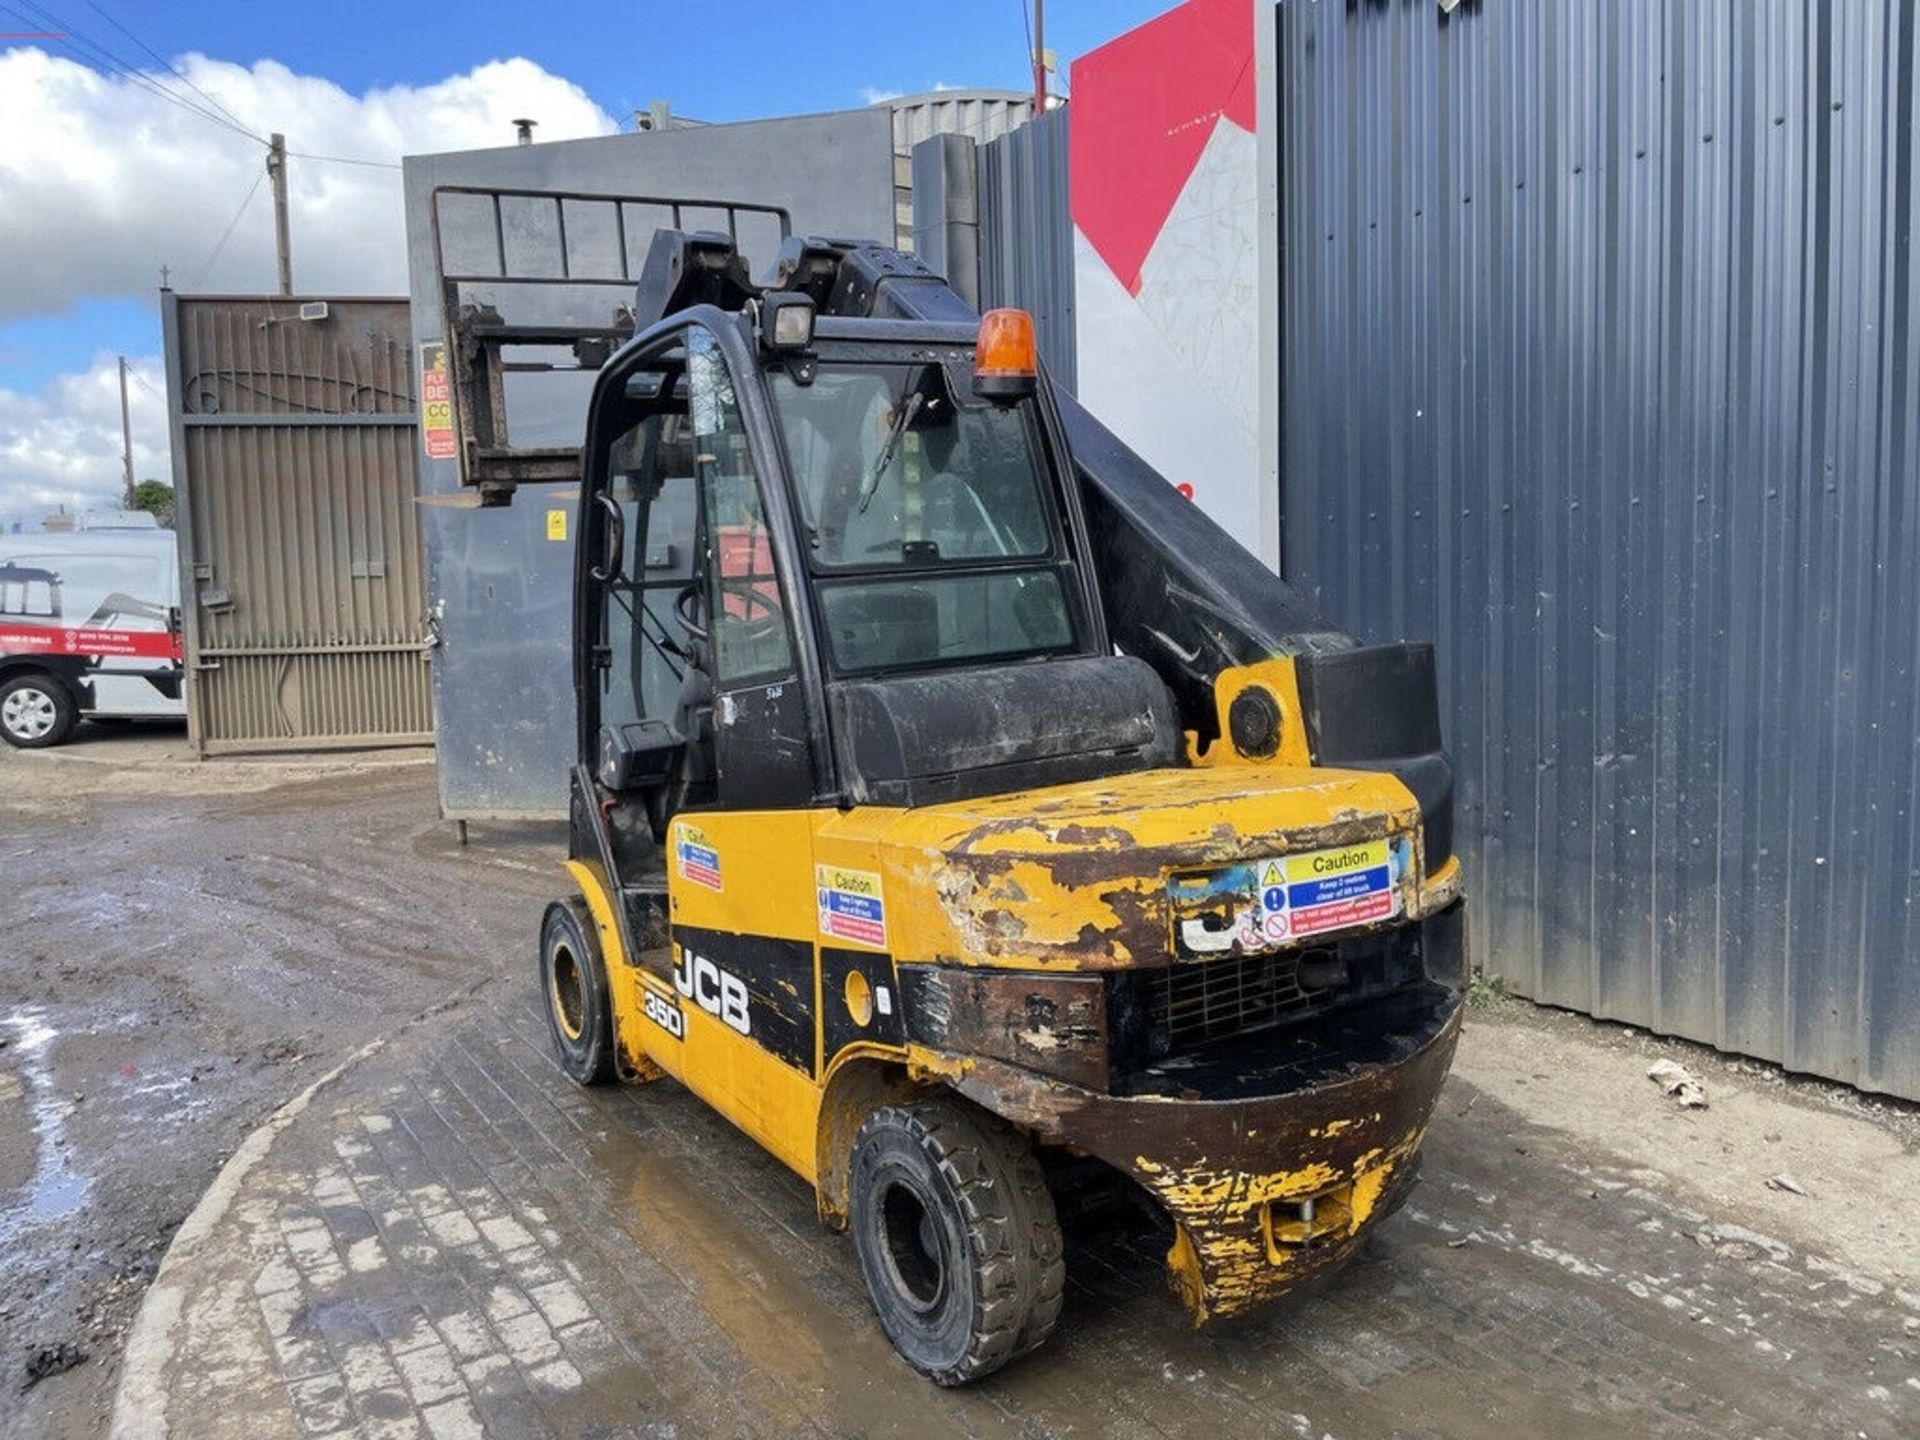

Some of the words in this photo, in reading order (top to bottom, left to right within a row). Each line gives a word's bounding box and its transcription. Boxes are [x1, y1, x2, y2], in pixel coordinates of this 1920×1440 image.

[1313, 851, 1369, 873] Caution
[835, 872, 873, 894] Caution
[1316, 891, 1335, 902] clear
[1336, 888, 1344, 897] of
[1354, 883, 1370, 894] truck
[1319, 880, 1338, 891] Keep
[1344, 874, 1367, 885] metres
[674, 948, 750, 1036] JCB
